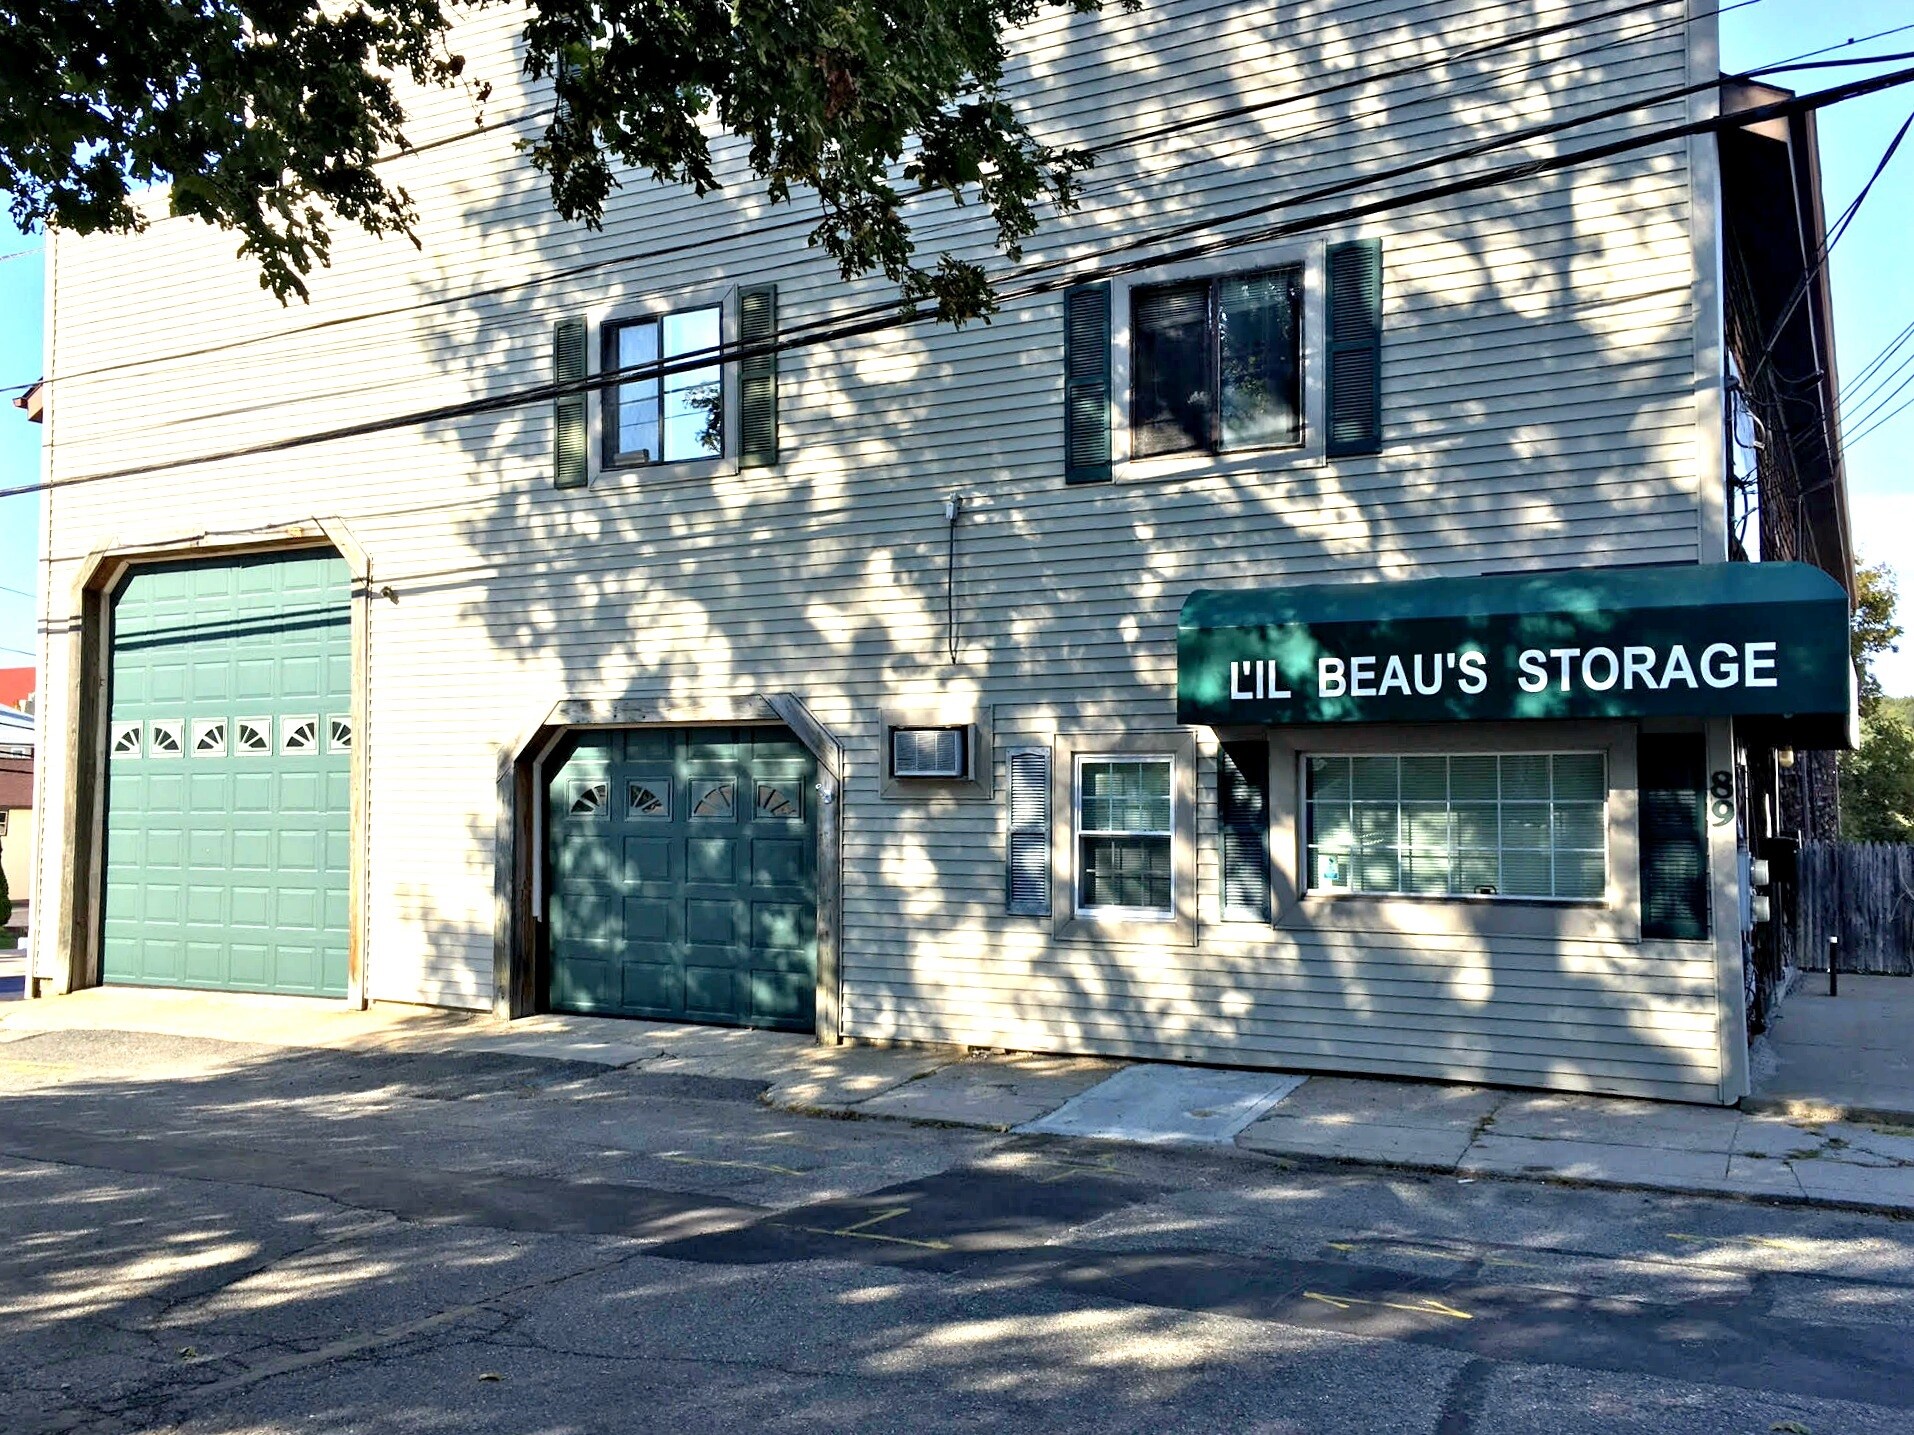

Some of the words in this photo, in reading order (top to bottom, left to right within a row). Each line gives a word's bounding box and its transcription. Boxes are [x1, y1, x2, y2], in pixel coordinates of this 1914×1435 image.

[1230, 660, 1292, 700] L'IL
[1318, 650, 1488, 698] BEAU'S
[1517, 641, 1778, 693] STORAGE
[1710, 770, 1735, 828] 89
